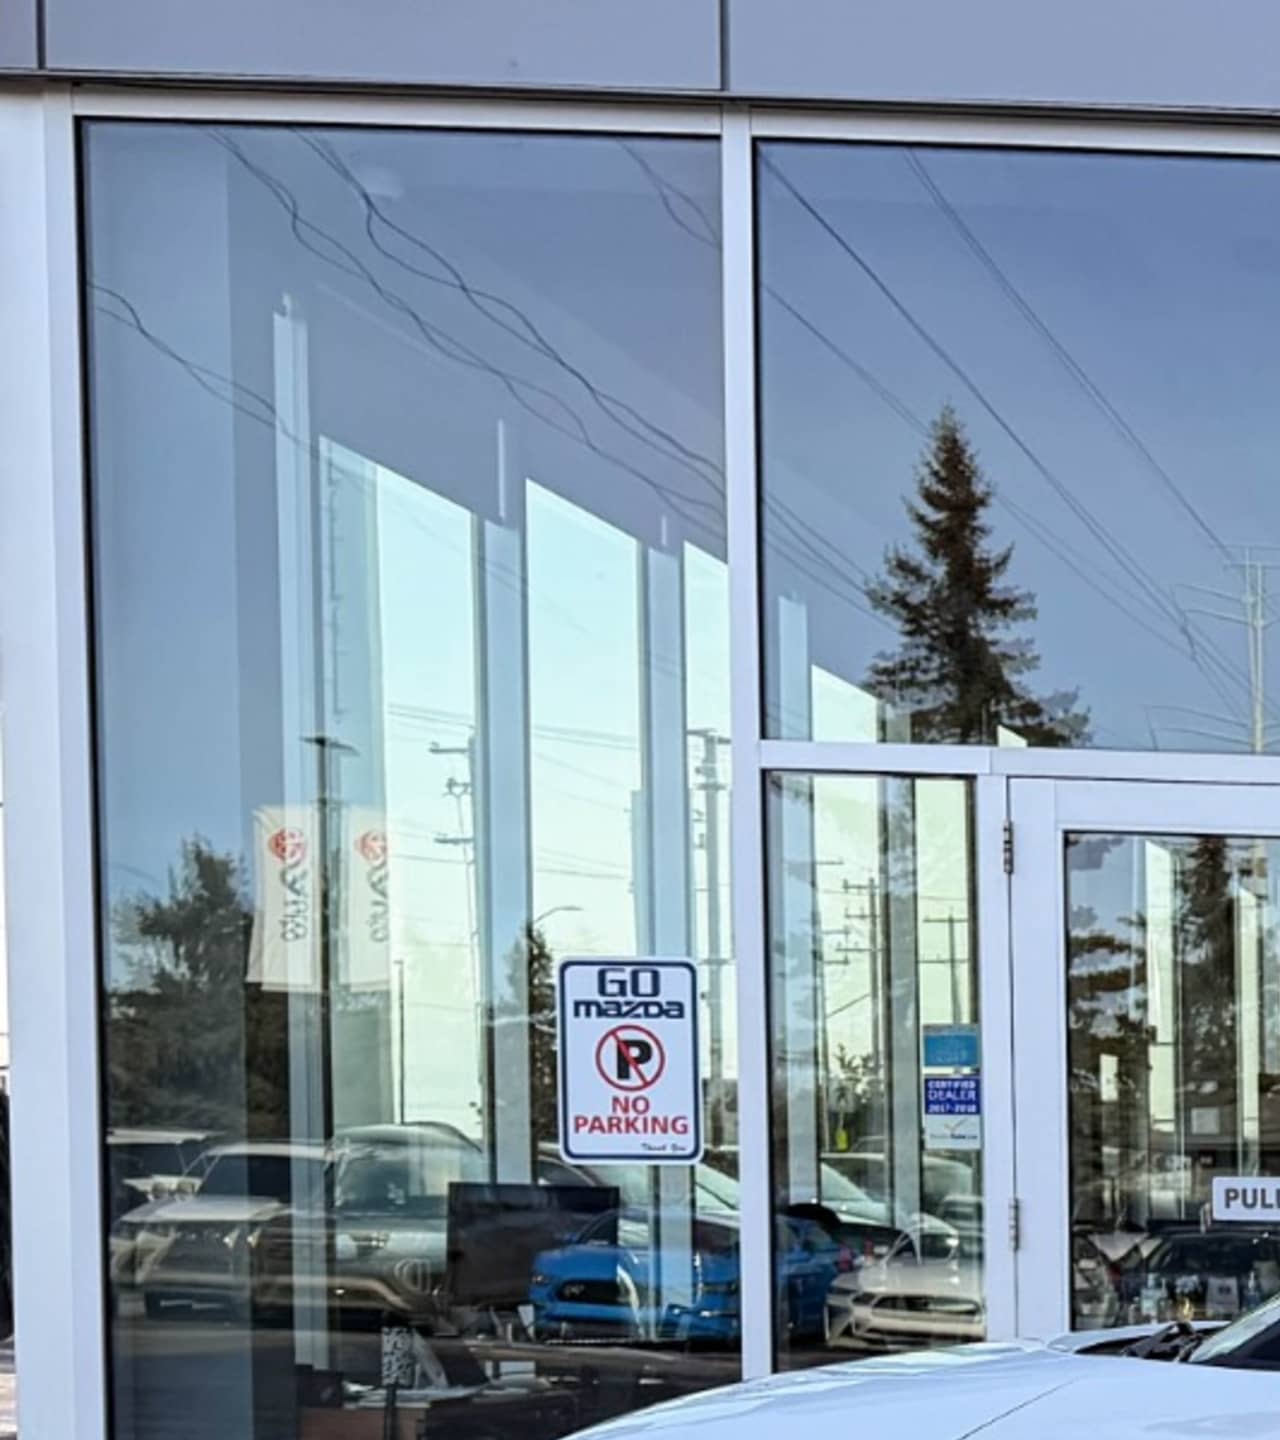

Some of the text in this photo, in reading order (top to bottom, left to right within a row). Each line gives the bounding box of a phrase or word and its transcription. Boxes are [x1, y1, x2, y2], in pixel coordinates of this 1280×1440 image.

[597, 968, 660, 997] GO
[612, 1096, 650, 1114] NO
[928, 1090, 976, 1101] DEALER
[574, 1115, 689, 1135] PARKING
